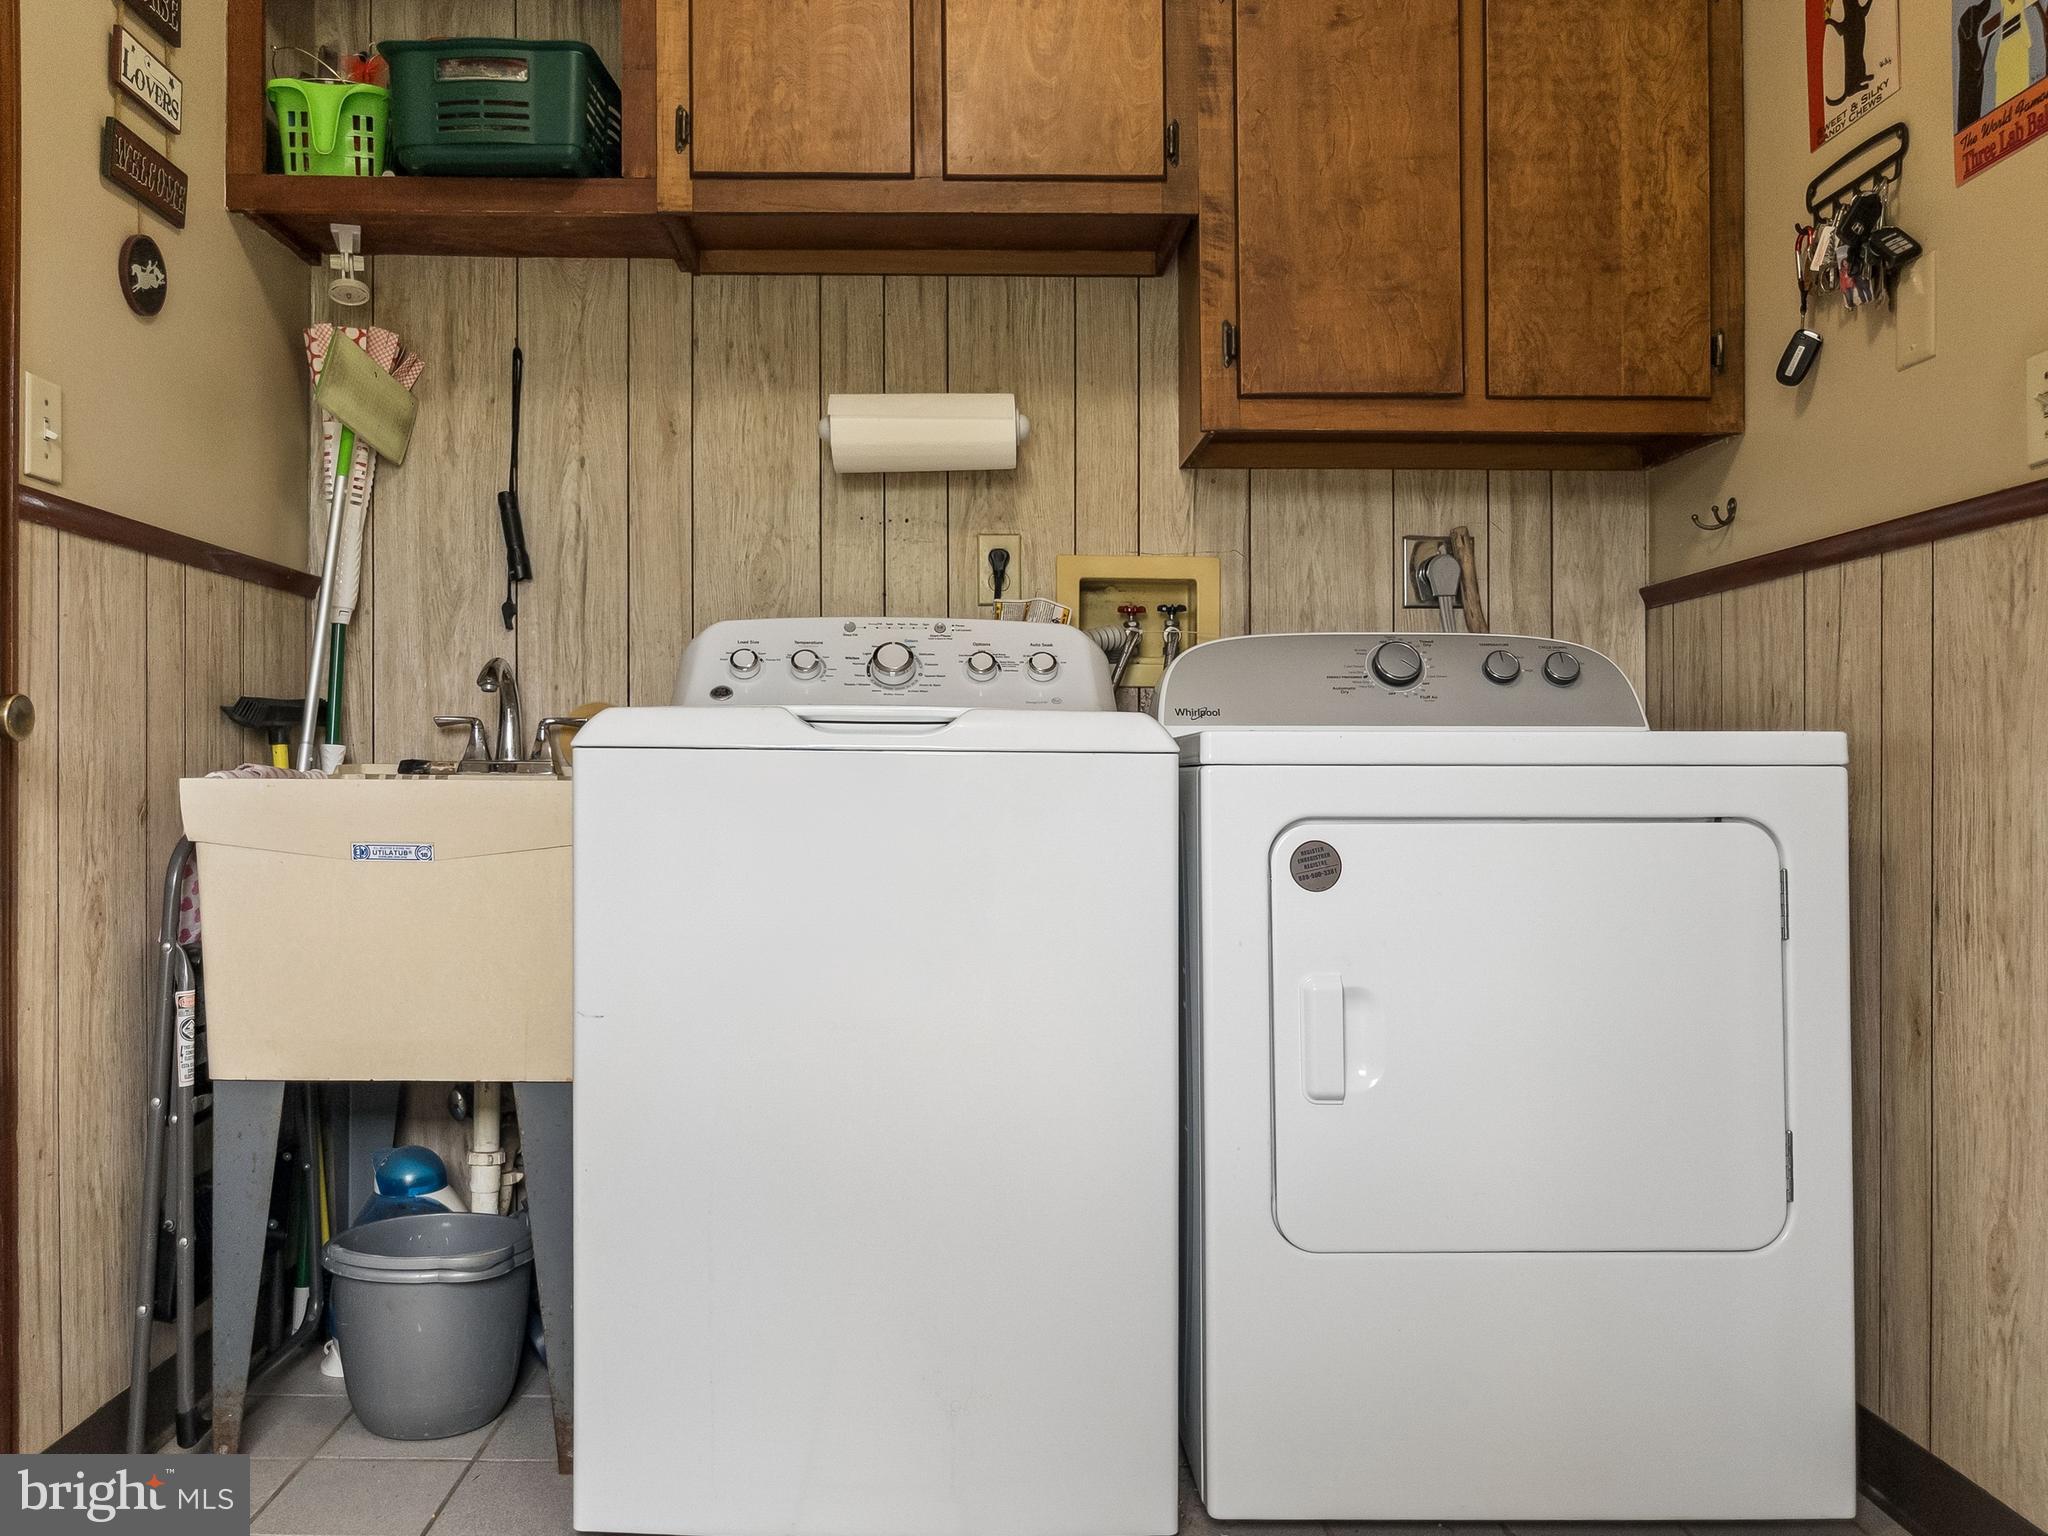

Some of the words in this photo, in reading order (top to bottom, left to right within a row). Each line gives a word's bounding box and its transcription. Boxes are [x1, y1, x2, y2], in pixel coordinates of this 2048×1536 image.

[122, 47, 180, 121] LOVERS
[1817, 109, 1847, 139] SWEET
[1850, 102, 1858, 112] &
[1861, 78, 1889, 105] SILKY
[1817, 120, 1846, 146] CANDY
[1848, 93, 1882, 122] CHEWS
[1960, 131, 1977, 151] The
[1981, 104, 2013, 138] World
[1963, 142, 1997, 173] Three
[2000, 120, 2024, 149] Lab
[115, 134, 185, 215] WELCOME
[1174, 707, 1220, 720] Whirlpool
